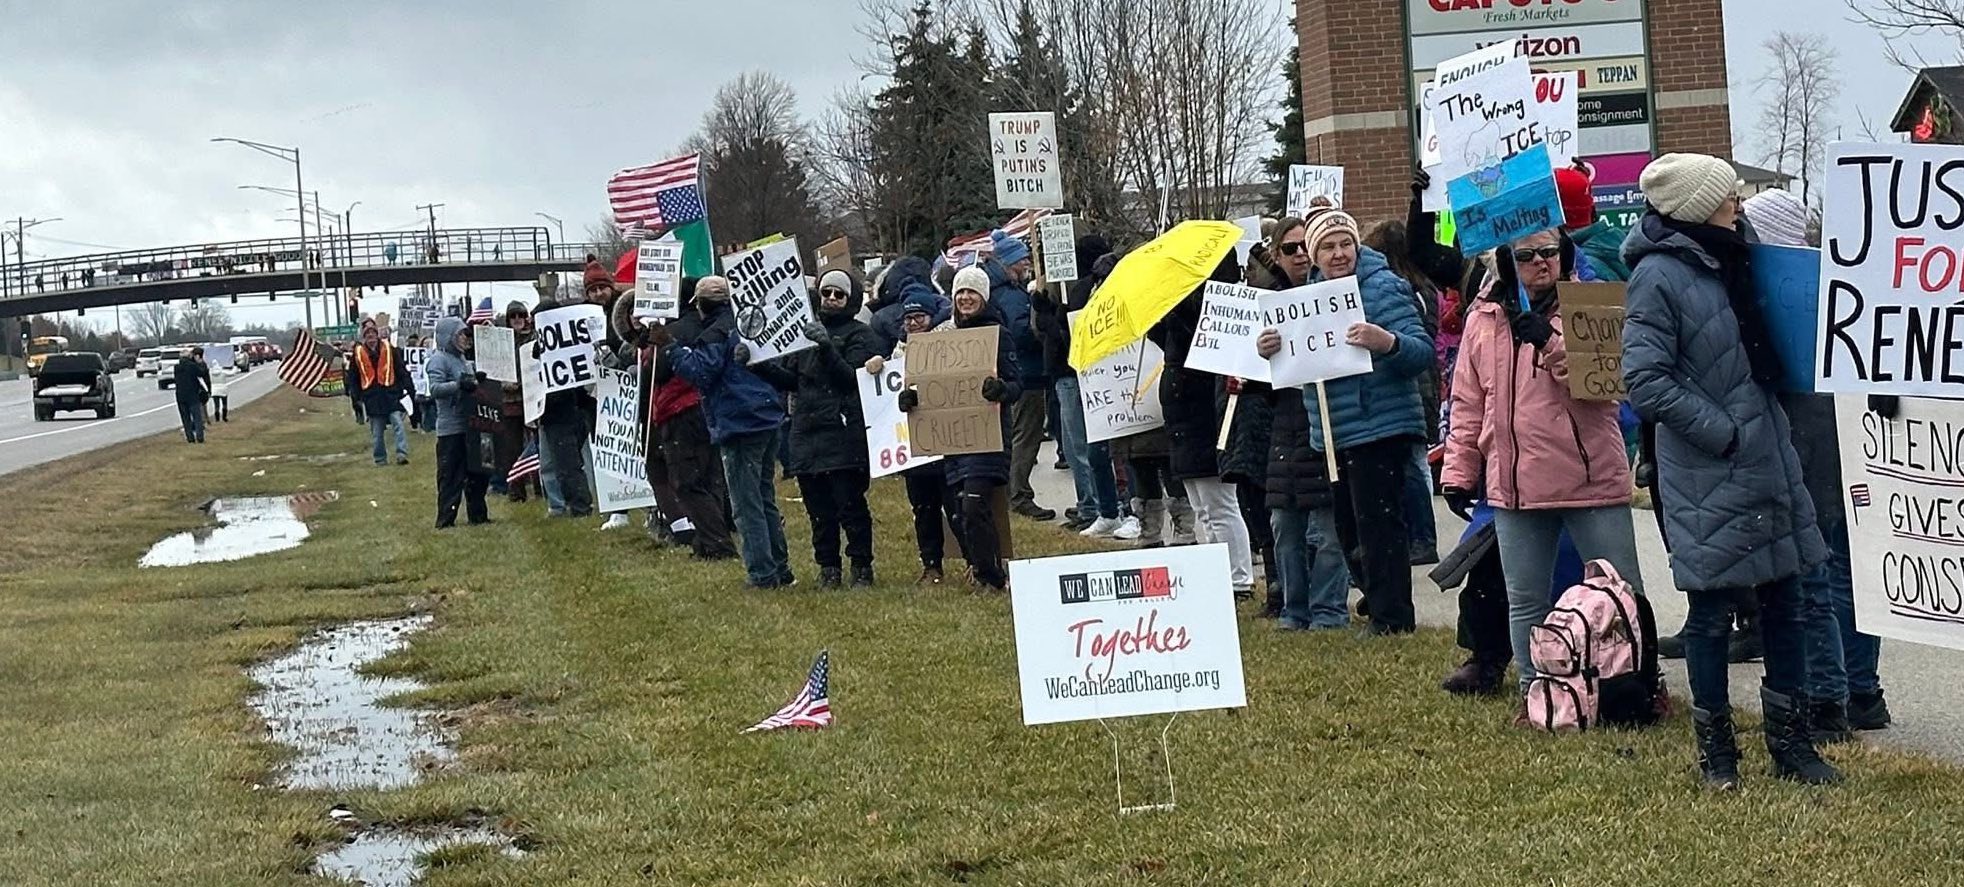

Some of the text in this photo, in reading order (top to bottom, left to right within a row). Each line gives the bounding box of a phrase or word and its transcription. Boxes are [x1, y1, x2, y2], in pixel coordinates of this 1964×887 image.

[1484, 7, 1570, 23] Fresh Markets
[1476, 34, 1581, 58] rizon
[1597, 65, 1638, 83] TEPPAN
[1532, 77, 1564, 104] OU
[1439, 92, 1483, 122] The
[1481, 99, 1526, 121] Wrong
[1578, 100, 1602, 111] ome
[1578, 109, 1643, 123] onsignment
[1000, 120, 1041, 135] TRUMP
[1015, 139, 1027, 154] IS
[1500, 121, 1543, 162] ICE
[1001, 156, 1047, 174] PUTIN'S
[1006, 178, 1044, 193] BITCH
[1593, 194, 1625, 205] assage
[1459, 207, 1488, 230] Is
[1492, 204, 1551, 239] Melting
[726, 249, 765, 289] STOP
[1892, 236, 1964, 293] FO
[731, 255, 802, 310] killing
[1206, 284, 1257, 301] ABOLISH
[774, 286, 796, 311] and
[1097, 295, 1116, 318] NO
[1263, 292, 1359, 327] ABOLISH
[753, 297, 804, 349] KIDNAPPING
[1204, 300, 1261, 323] INHUMAN
[539, 319, 592, 355] BOLIS
[1200, 317, 1250, 336] CALLOUS
[1571, 311, 1626, 342] Chan
[1289, 331, 1336, 357] ICE
[907, 339, 993, 376] COMPASSION
[615, 370, 638, 388] YOU
[1113, 363, 1136, 379] you
[619, 386, 635, 400] NO
[873, 371, 903, 397] IC
[926, 376, 985, 408] OVER
[1584, 371, 1627, 396] Goo
[1086, 388, 1143, 410] ARE th
[477, 403, 500, 423] LIKE
[1107, 410, 1154, 427] problem
[596, 433, 615, 449] NOT
[607, 421, 627, 437] YOU
[916, 411, 991, 451] CRUELTY
[595, 449, 647, 480] ATTENTIO
[880, 445, 907, 469] 86
[1063, 579, 1084, 599] WE
[1090, 576, 1113, 598] CAN
[1116, 574, 1142, 595] LEAD
[1883, 551, 1964, 614] CONS
[1067, 608, 1191, 684] Together
[1044, 669, 1221, 701] WeCanLeadChange.org
